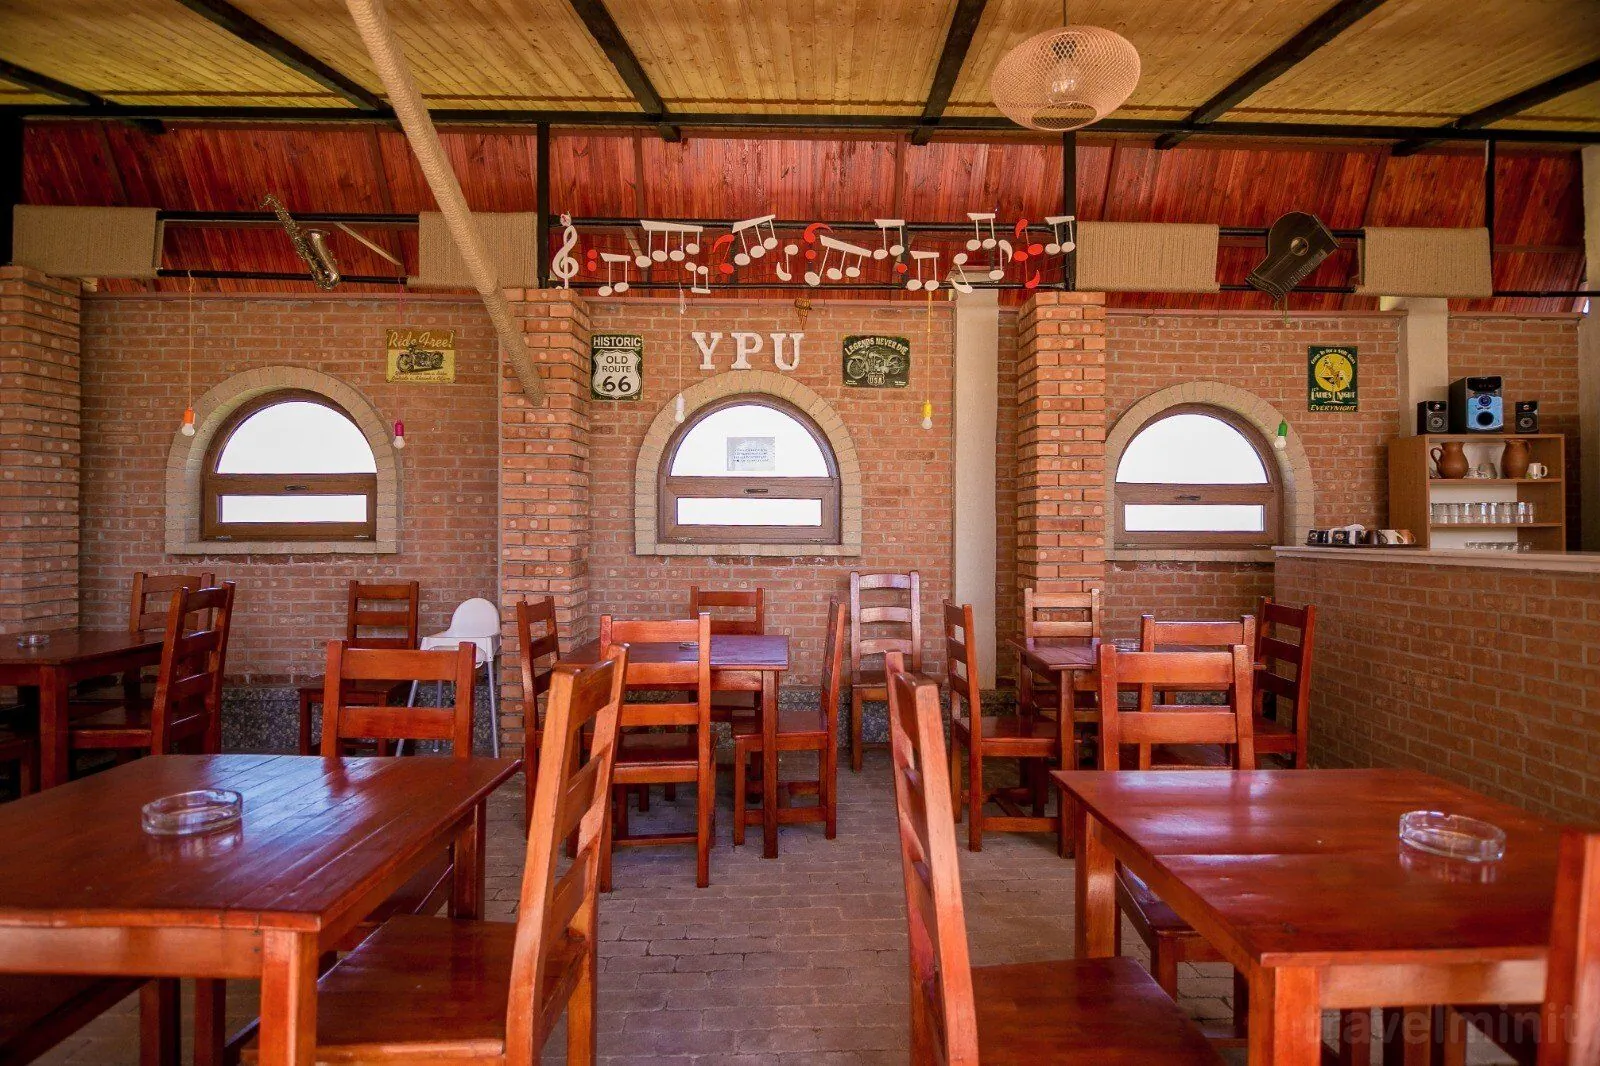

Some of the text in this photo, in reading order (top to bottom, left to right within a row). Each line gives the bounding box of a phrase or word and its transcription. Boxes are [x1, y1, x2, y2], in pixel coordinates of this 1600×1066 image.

[419, 331, 454, 349] Free!
[593, 336, 641, 347] HISTORIC
[844, 337, 909, 356] LEGENDS NEVER DIE
[691, 332, 804, 371] YPU
[606, 355, 628, 364] OLD
[602, 365, 631, 373] ROUTE
[602, 375, 631, 393] 66
[869, 377, 883, 385] USA
